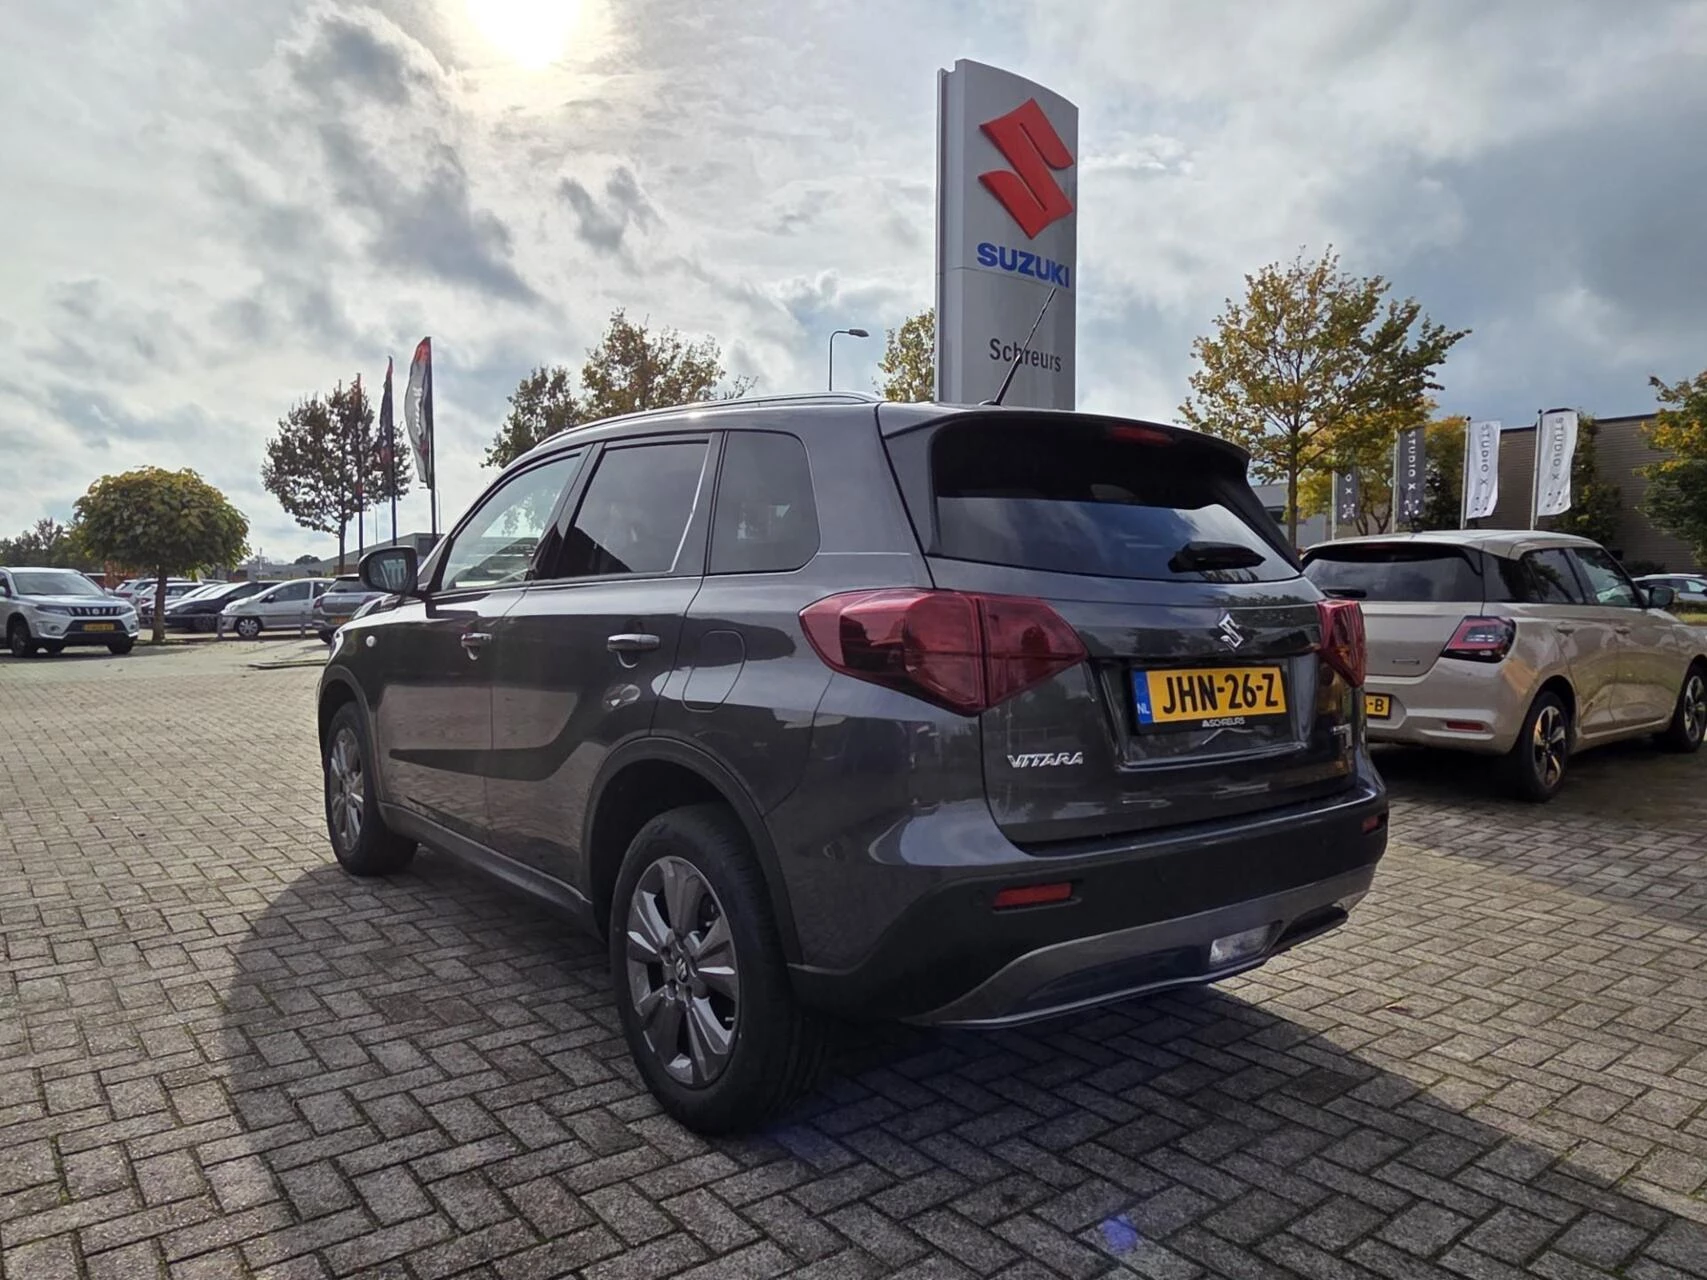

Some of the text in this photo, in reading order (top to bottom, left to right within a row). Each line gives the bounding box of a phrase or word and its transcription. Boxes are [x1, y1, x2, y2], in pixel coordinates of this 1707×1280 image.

[976, 242, 1070, 288] SUZUKI
[989, 337, 1062, 372] Schreurs
[1408, 430, 1417, 477] STUDIO
[1480, 423, 1491, 473] STUDIO
[1553, 416, 1565, 467] STUDIO
[1136, 702, 1151, 715] NL
[1162, 673, 1279, 714] JHN-26-Z
[1007, 751, 1084, 769] VITARA
